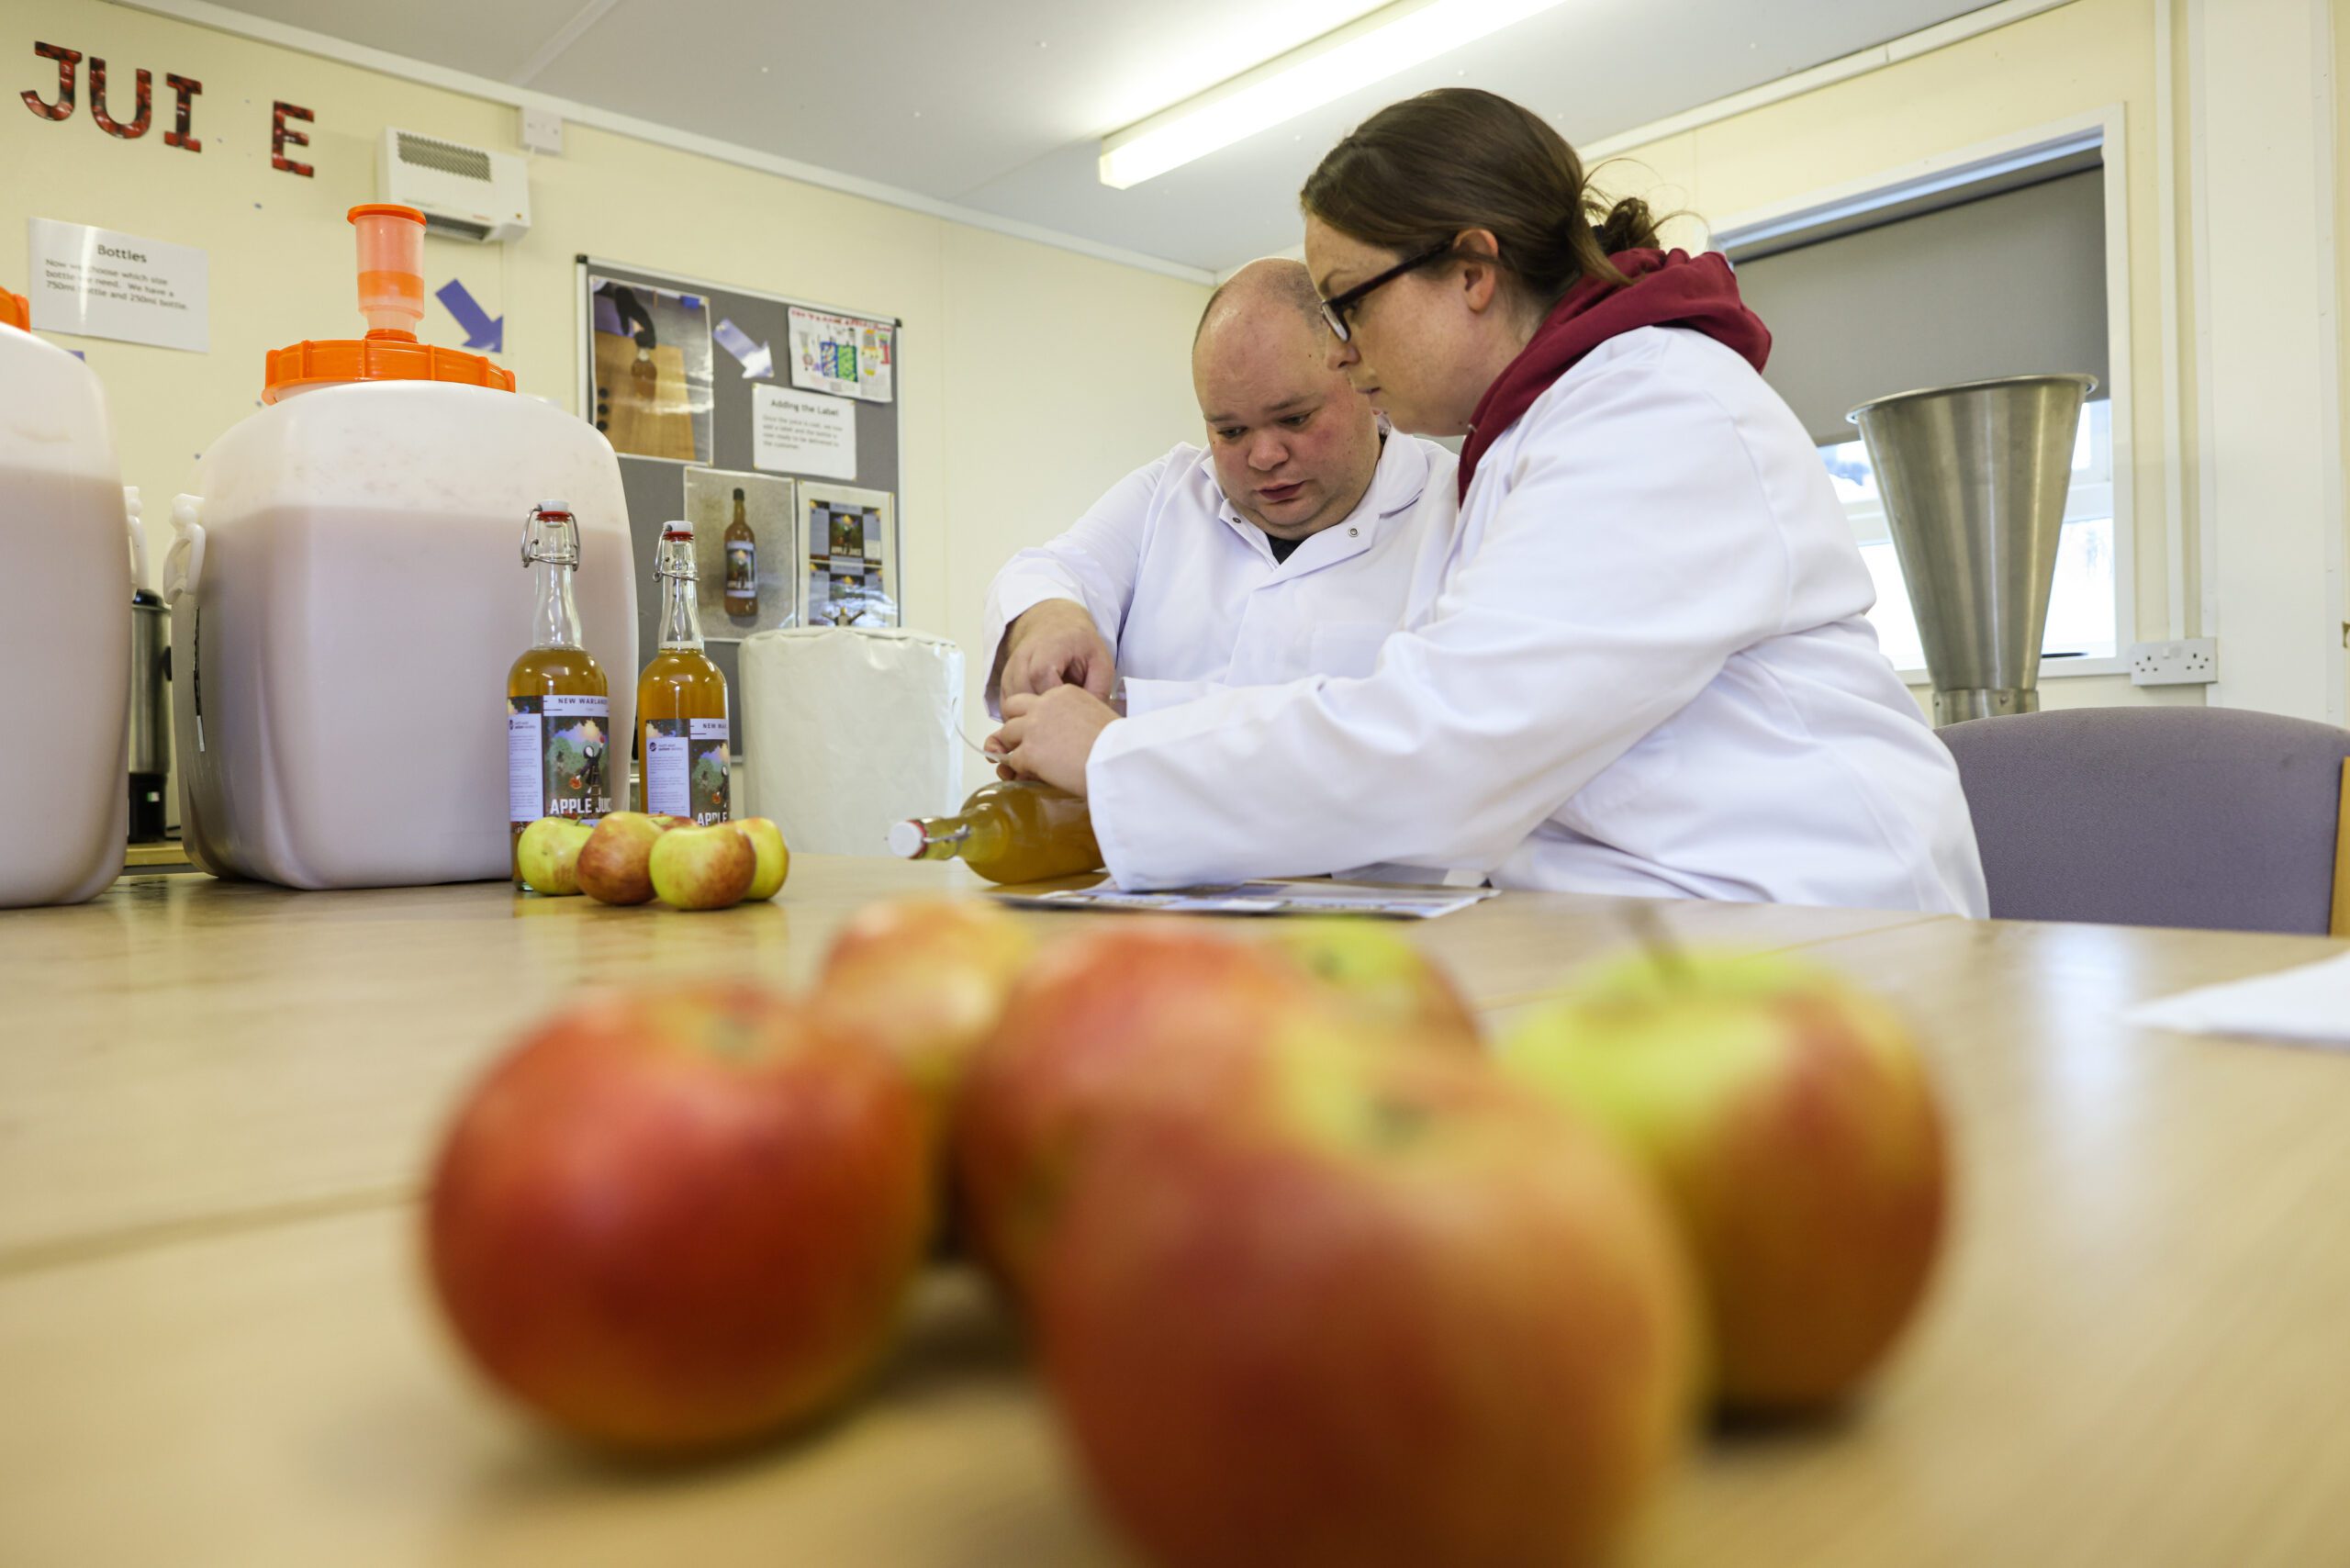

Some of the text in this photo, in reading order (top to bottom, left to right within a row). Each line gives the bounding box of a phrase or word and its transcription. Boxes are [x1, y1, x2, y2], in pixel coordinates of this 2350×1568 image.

[97, 244, 147, 263] Bottles
[45, 258, 66, 268] Now
[122, 271, 148, 282] which
[45, 269, 75, 281] bottle
[145, 285, 166, 296] have
[109, 291, 127, 300] and
[771, 398, 839, 417] Adding the Label
[550, 798, 593, 815] APPLE
